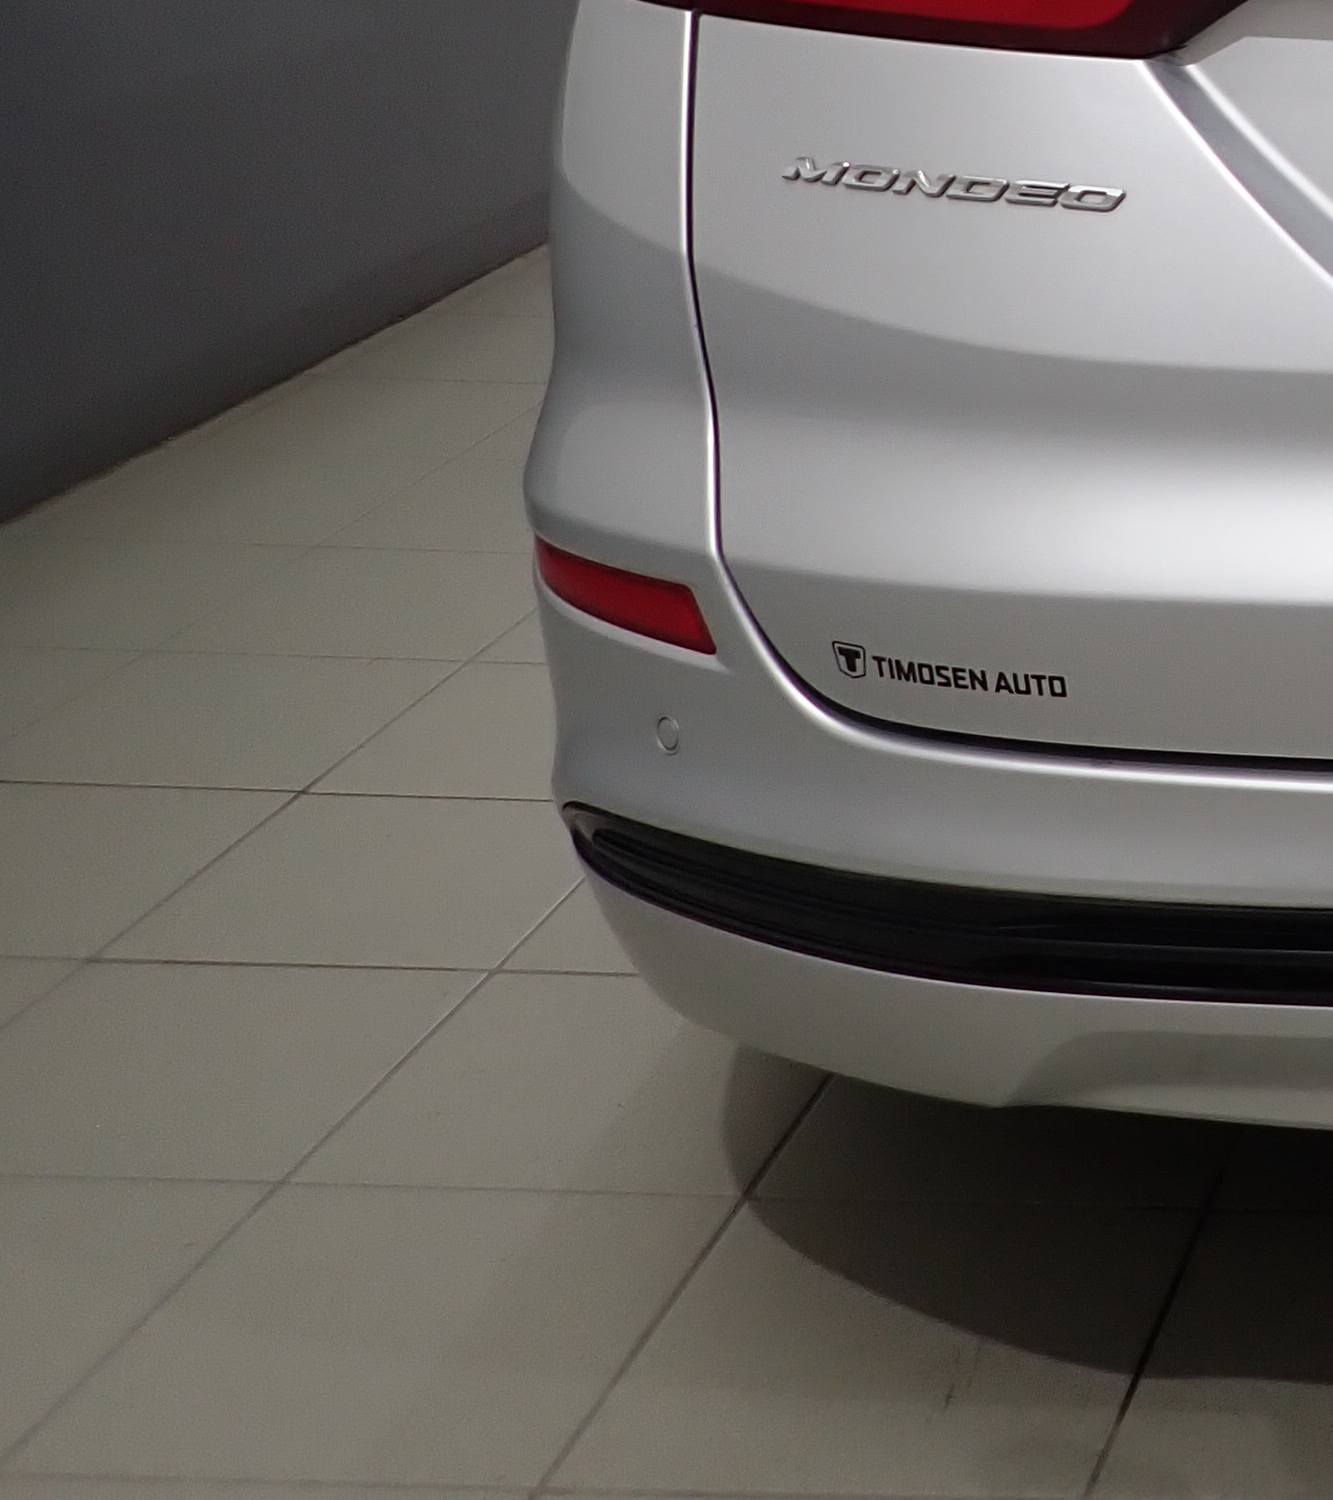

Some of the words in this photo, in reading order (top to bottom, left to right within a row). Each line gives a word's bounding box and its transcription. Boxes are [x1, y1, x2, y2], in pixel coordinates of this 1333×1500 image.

[782, 156, 1127, 212] MONDEO
[872, 655, 988, 692] TIMOSEN
[995, 671, 1067, 698] AUTO
